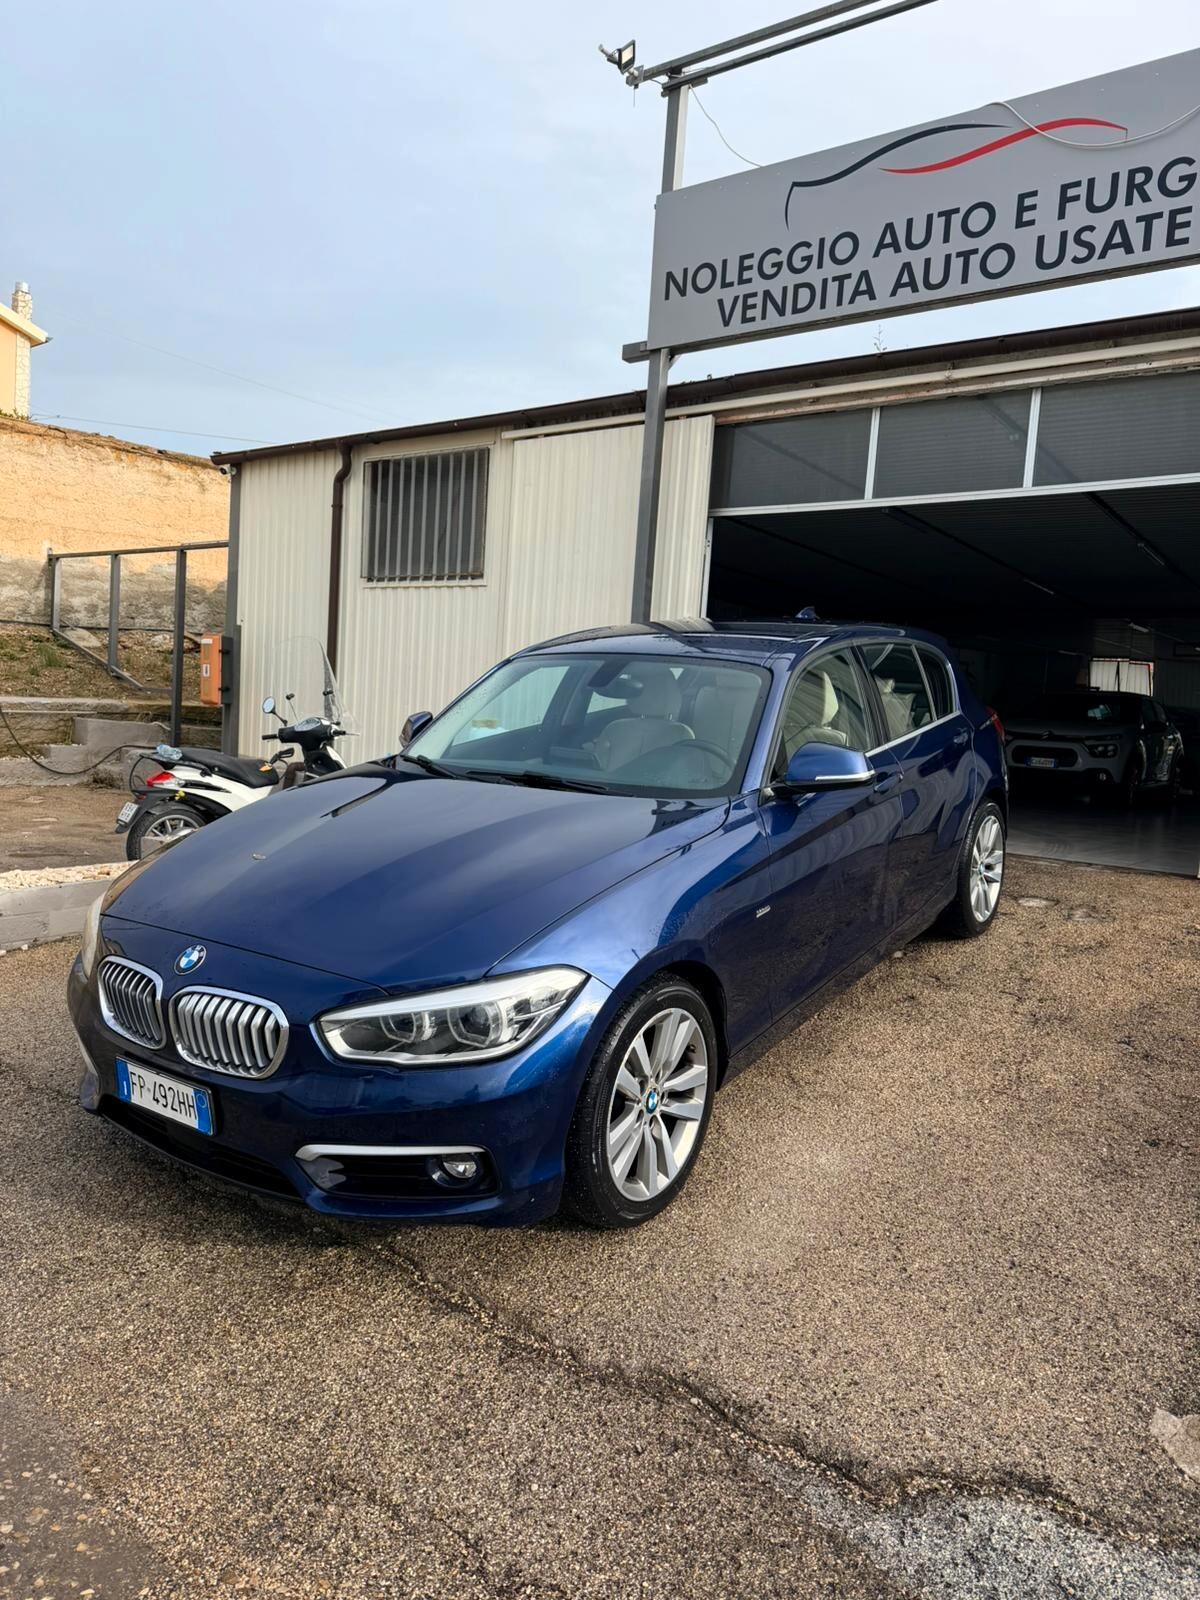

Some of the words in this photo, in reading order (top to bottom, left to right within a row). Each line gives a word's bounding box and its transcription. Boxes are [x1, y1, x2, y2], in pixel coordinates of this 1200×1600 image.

[664, 231, 860, 301] NOLEGGIO
[871, 201, 997, 259] AUTO
[1014, 189, 1039, 230] E
[1057, 156, 1199, 221] FURG
[716, 269, 877, 328] VENDITA
[888, 242, 1017, 298] AUTO
[1035, 205, 1193, 271] USATE
